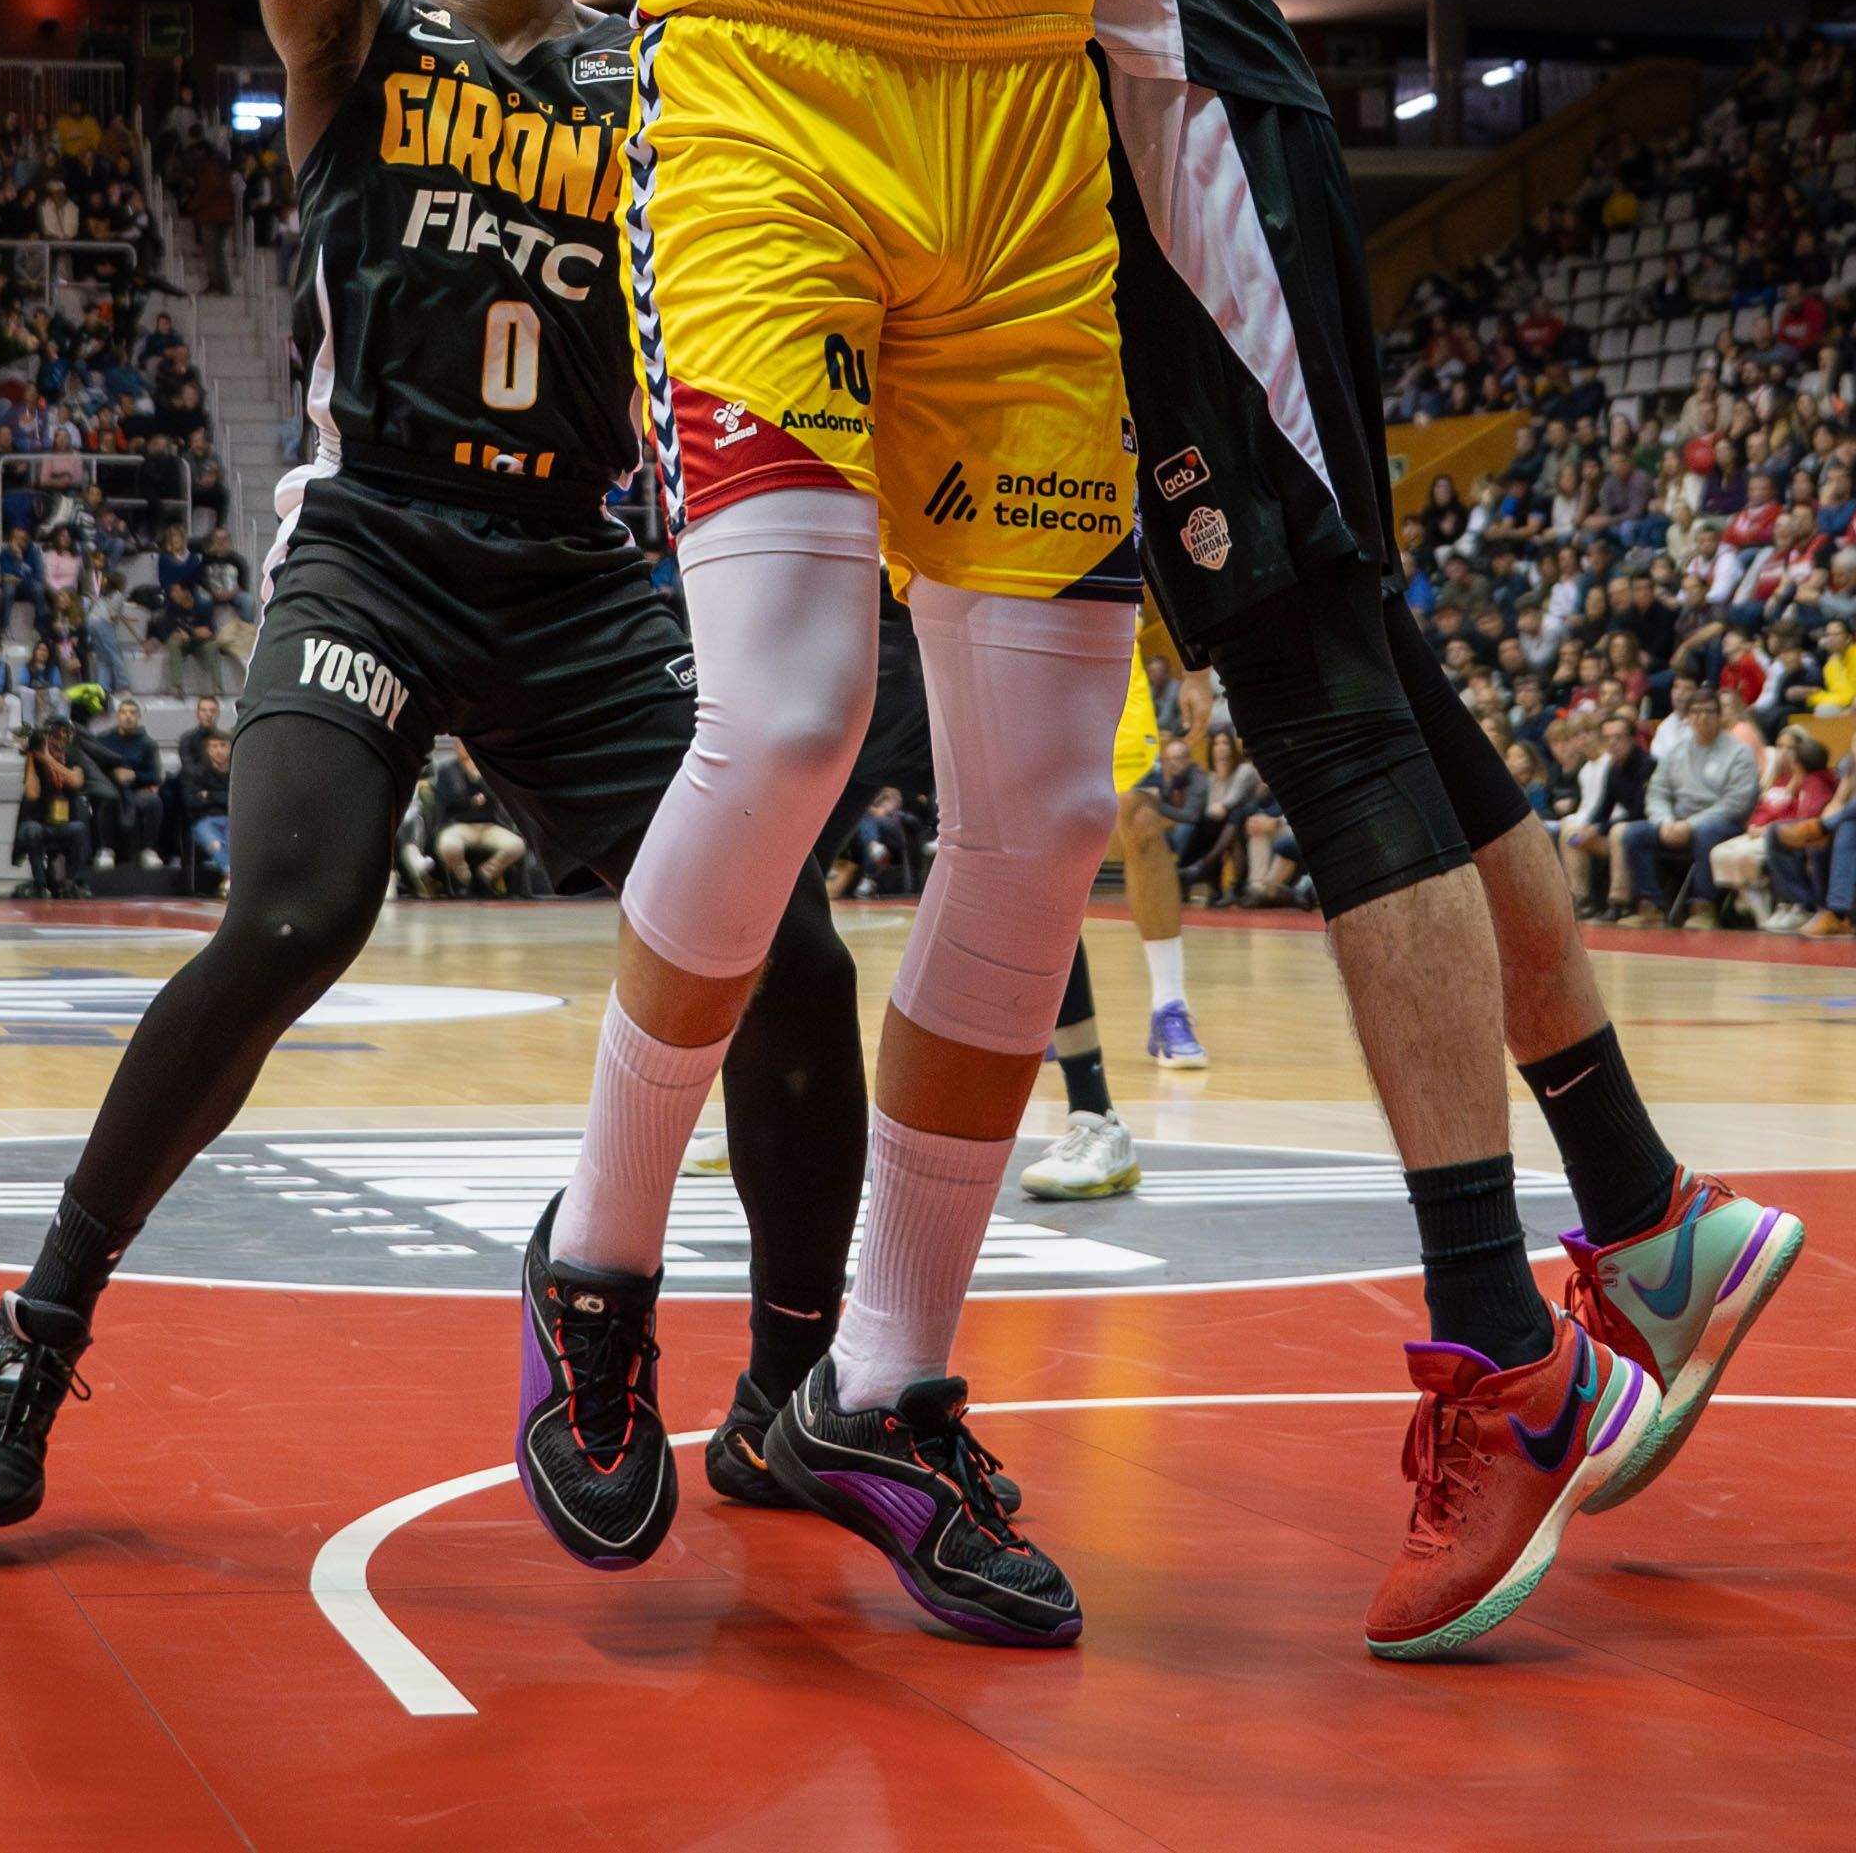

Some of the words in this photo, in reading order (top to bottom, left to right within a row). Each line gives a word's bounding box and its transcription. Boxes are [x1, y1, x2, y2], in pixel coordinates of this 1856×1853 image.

[420, 54, 615, 126] BÀQUET
[380, 72, 628, 222] GIRONA
[401, 189, 604, 302] FIATC
[481, 300, 541, 411] 0
[714, 422, 758, 450] hummel
[781, 408, 864, 436] Andorra
[996, 471, 1117, 503] andorra
[1164, 467, 1196, 494] acb
[993, 501, 1122, 536] telecom
[1193, 534, 1231, 562] GIRONA
[299, 638, 410, 731] YOSOY
